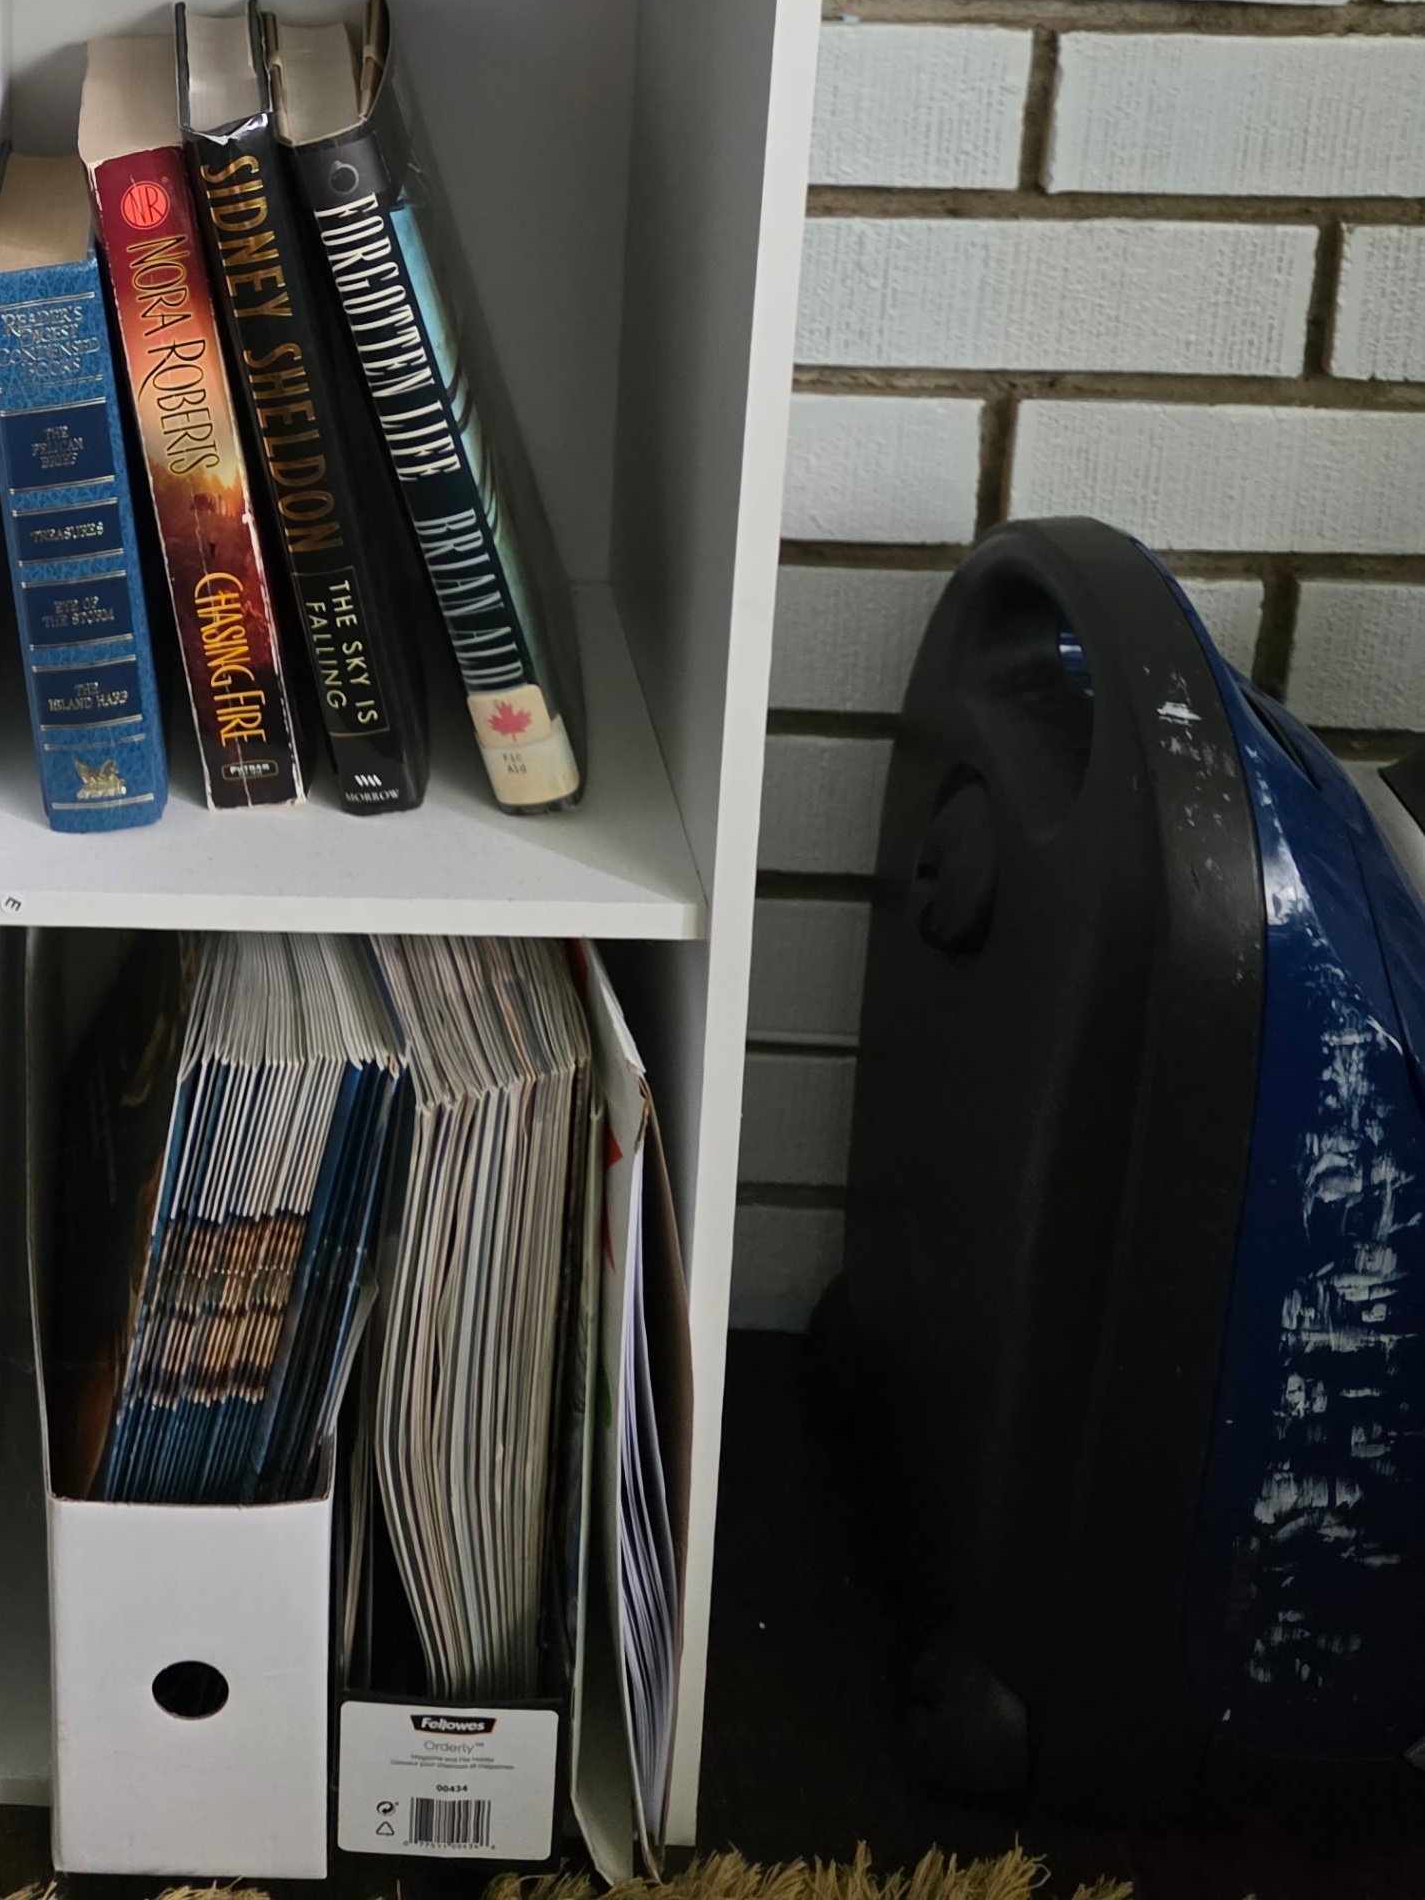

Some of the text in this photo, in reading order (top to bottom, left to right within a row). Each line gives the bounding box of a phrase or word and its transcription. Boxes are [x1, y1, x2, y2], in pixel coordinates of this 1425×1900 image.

[129, 185, 160, 227] NR
[0, 305, 84, 338] READER'S
[18, 323, 80, 348] DIGEST
[314, 192, 461, 482] FORGOTTEN LIFE
[126, 235, 220, 475] NORA ROBERTS
[199, 153, 345, 554] SIDNEY SHELDON
[43, 425, 69, 439] THE
[31, 436, 84, 456] PELICAN
[39, 452, 79, 469] BRIEF
[29, 520, 105, 544] TREASURES
[413, 506, 505, 616] BRIAN
[53, 595, 100, 615] EYE OF
[42, 607, 115, 628] THE STORM
[194, 571, 255, 688] CHASING
[305, 601, 347, 710] FALLING
[329, 579, 379, 724] THE SKY IS
[48, 690, 129, 712] ISLAND HARP
[75, 681, 100, 697] THE
[213, 690, 267, 748] FIRE
[345, 788, 401, 804] MORROW
[421, 1717, 486, 1731] Fellowes
[435, 1784, 468, 1793] 00434
